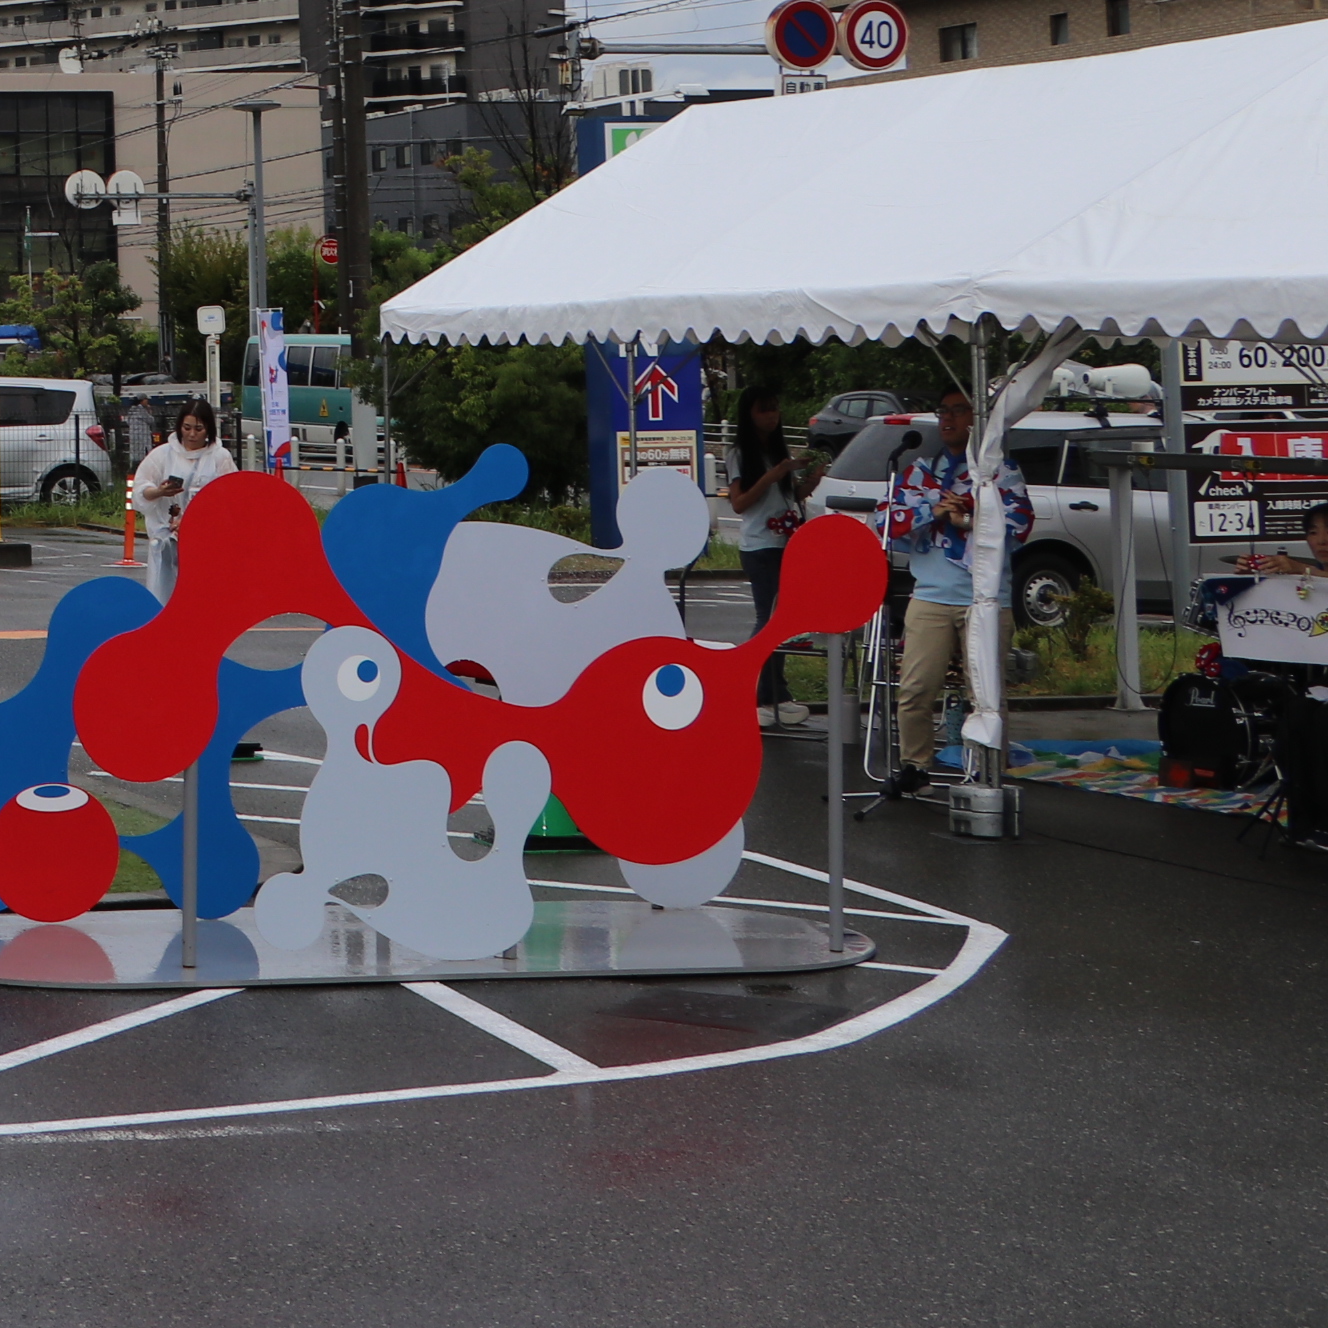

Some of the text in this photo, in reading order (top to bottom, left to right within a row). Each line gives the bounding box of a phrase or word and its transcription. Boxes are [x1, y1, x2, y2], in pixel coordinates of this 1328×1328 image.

[860, 20, 893, 49] 40
[786, 82, 824, 93] 自動車
[1187, 347, 1198, 376] 本料金
[1208, 361, 1232, 369] 24:00
[1213, 387, 1276, 396] ナンバープレート
[1208, 485, 1244, 497] check
[1209, 512, 1255, 532] 12-34
